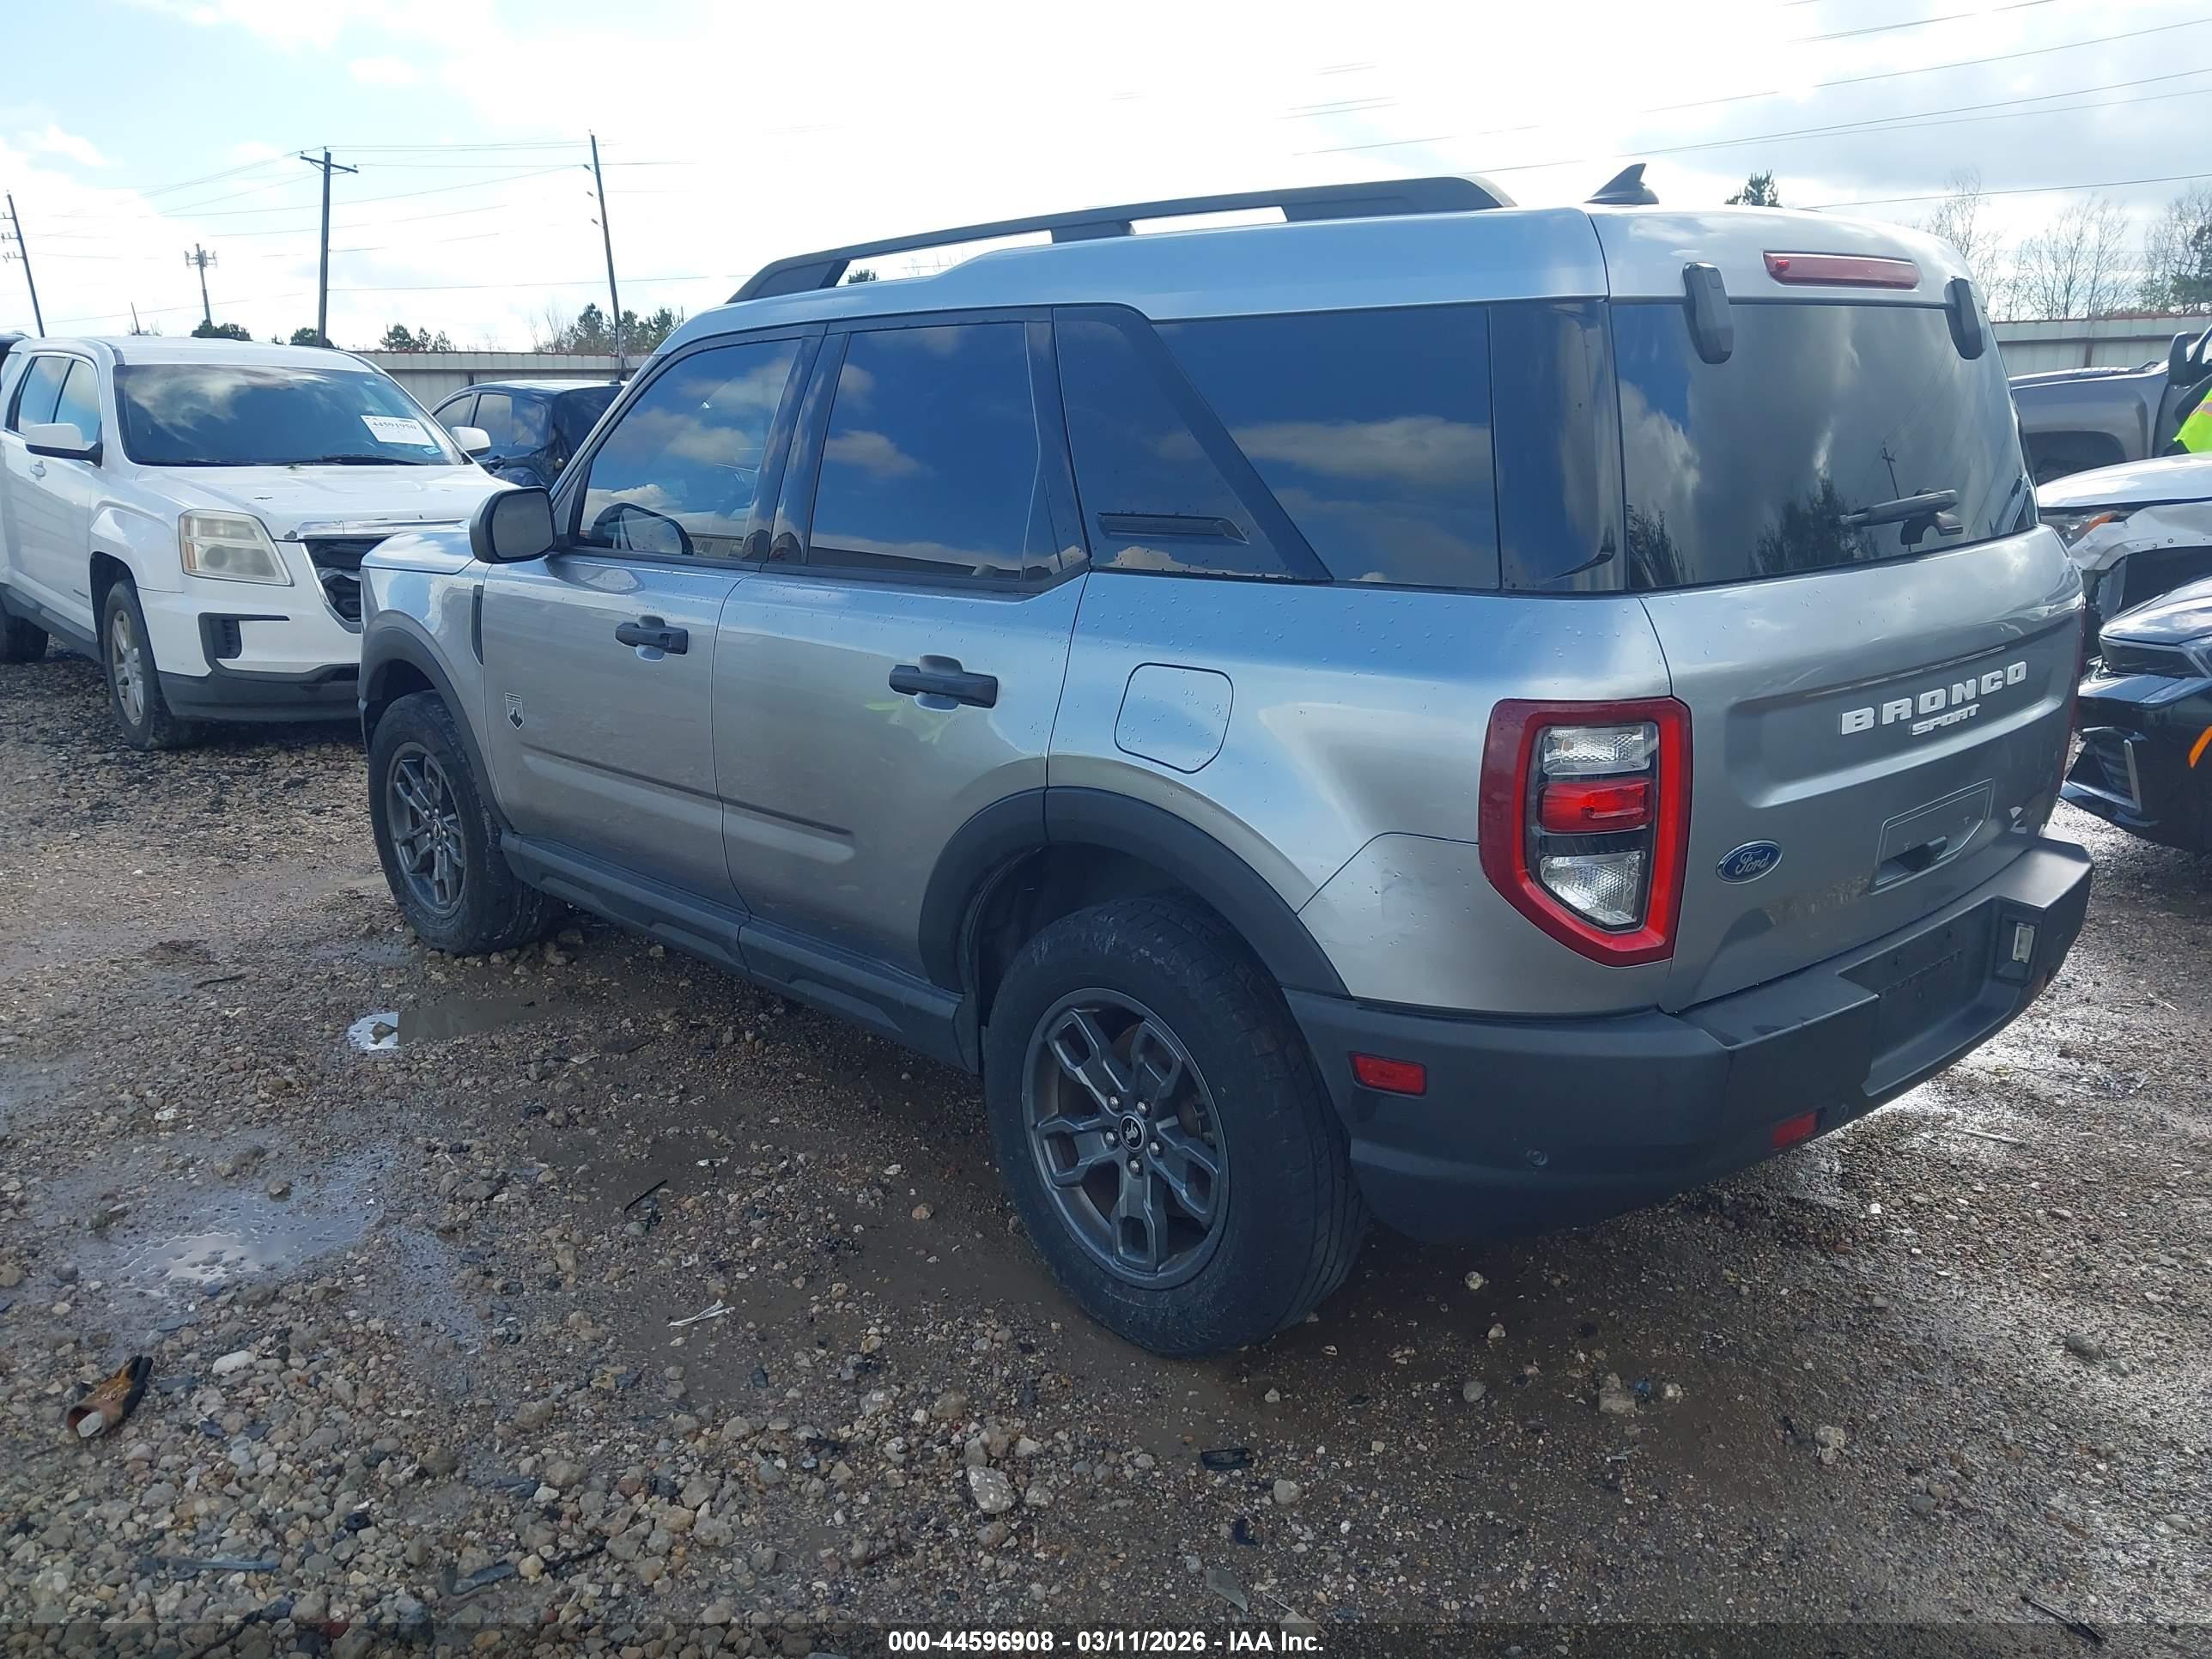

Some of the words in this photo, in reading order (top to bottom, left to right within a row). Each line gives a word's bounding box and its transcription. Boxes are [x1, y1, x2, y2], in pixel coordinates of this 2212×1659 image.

[1839, 660, 2028, 736] BRONCO
[1910, 703, 1981, 736] SPORT
[1735, 849, 1771, 875] Ford
